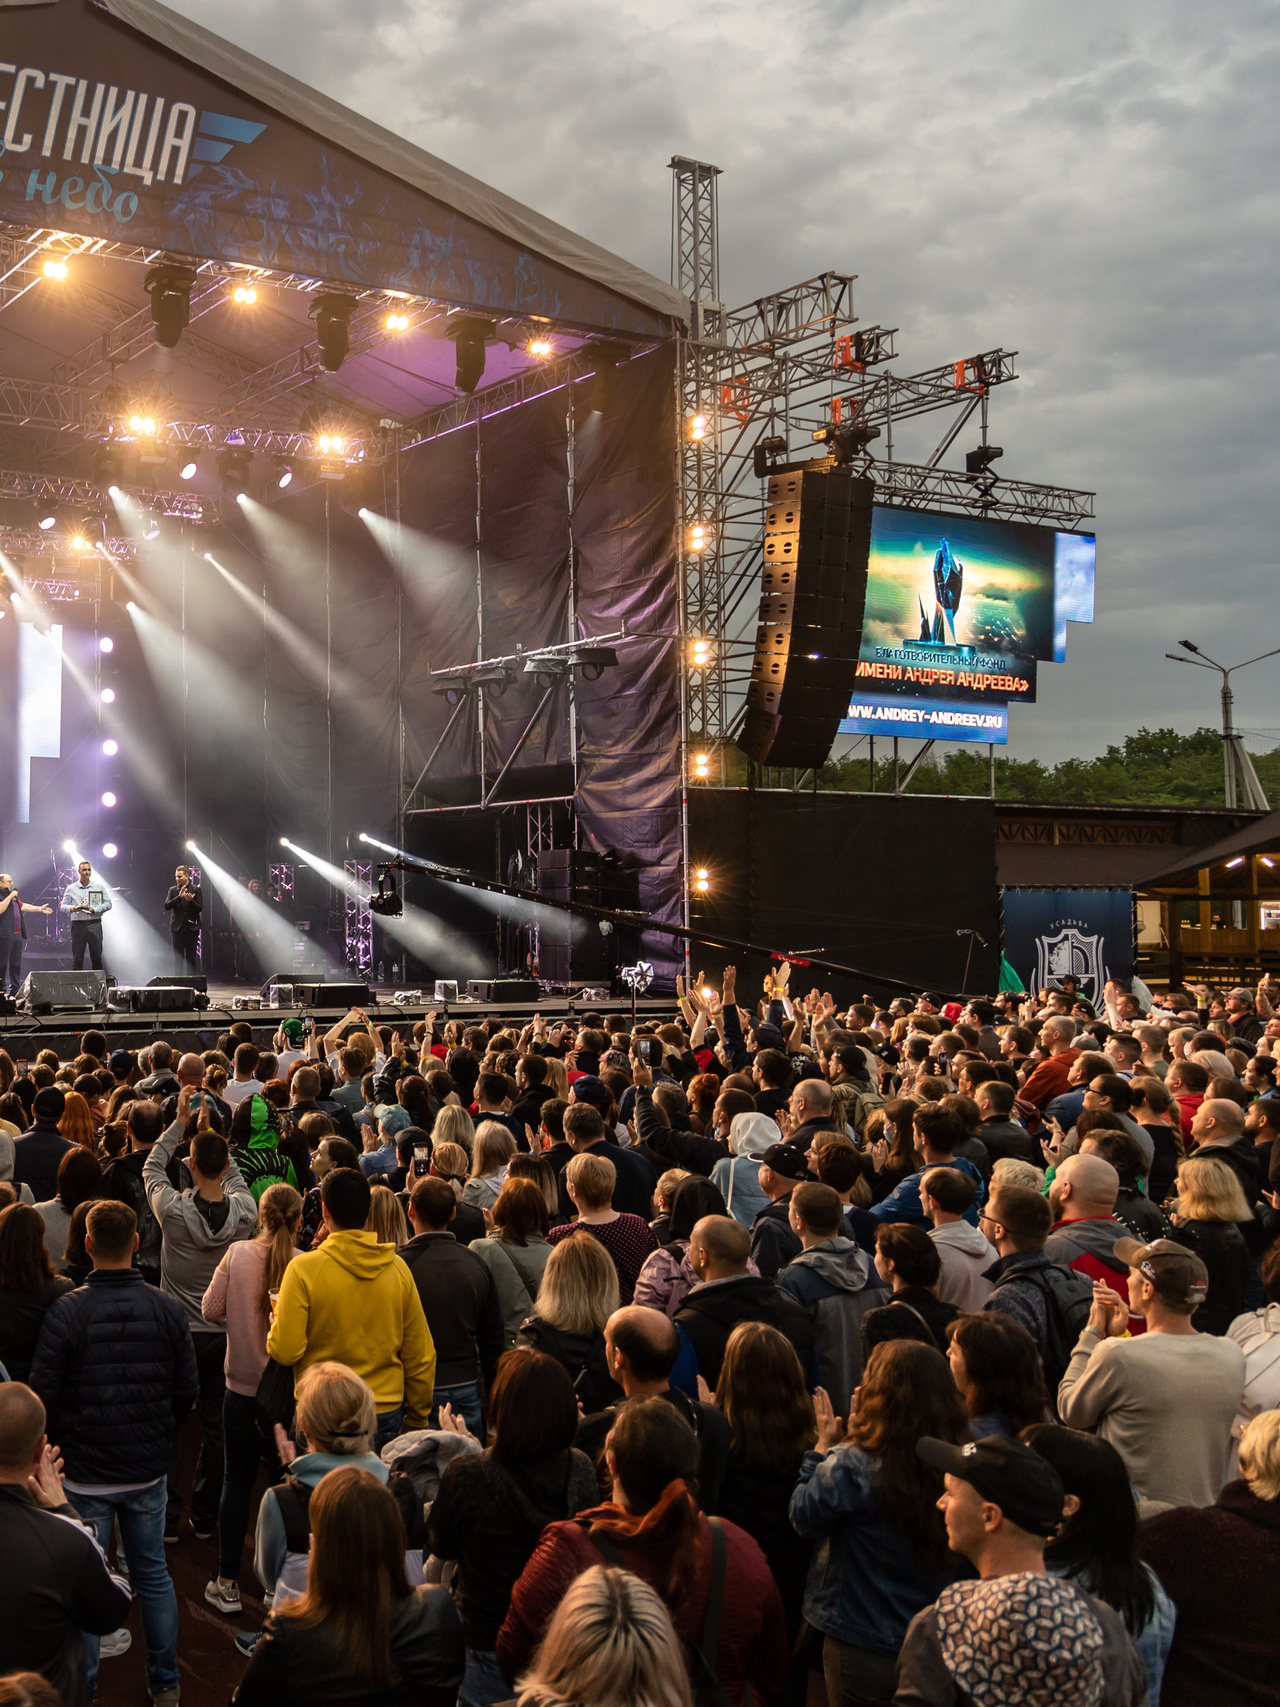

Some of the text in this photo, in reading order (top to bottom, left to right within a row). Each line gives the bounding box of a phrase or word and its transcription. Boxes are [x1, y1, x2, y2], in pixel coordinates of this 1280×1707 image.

[26, 164, 139, 223] небо
[875, 646, 1007, 672] БЛАГОТВОРИТЕЛЬНЫЙ ФОНД
[855, 662, 1030, 692] ИМЕНИ АНДРЕЯ АНДРЕЕВА»
[848, 705, 1003, 728] WW.ANDREY-ANDREEV.RU
[1050, 918, 1088, 929] УСАДЬБА
